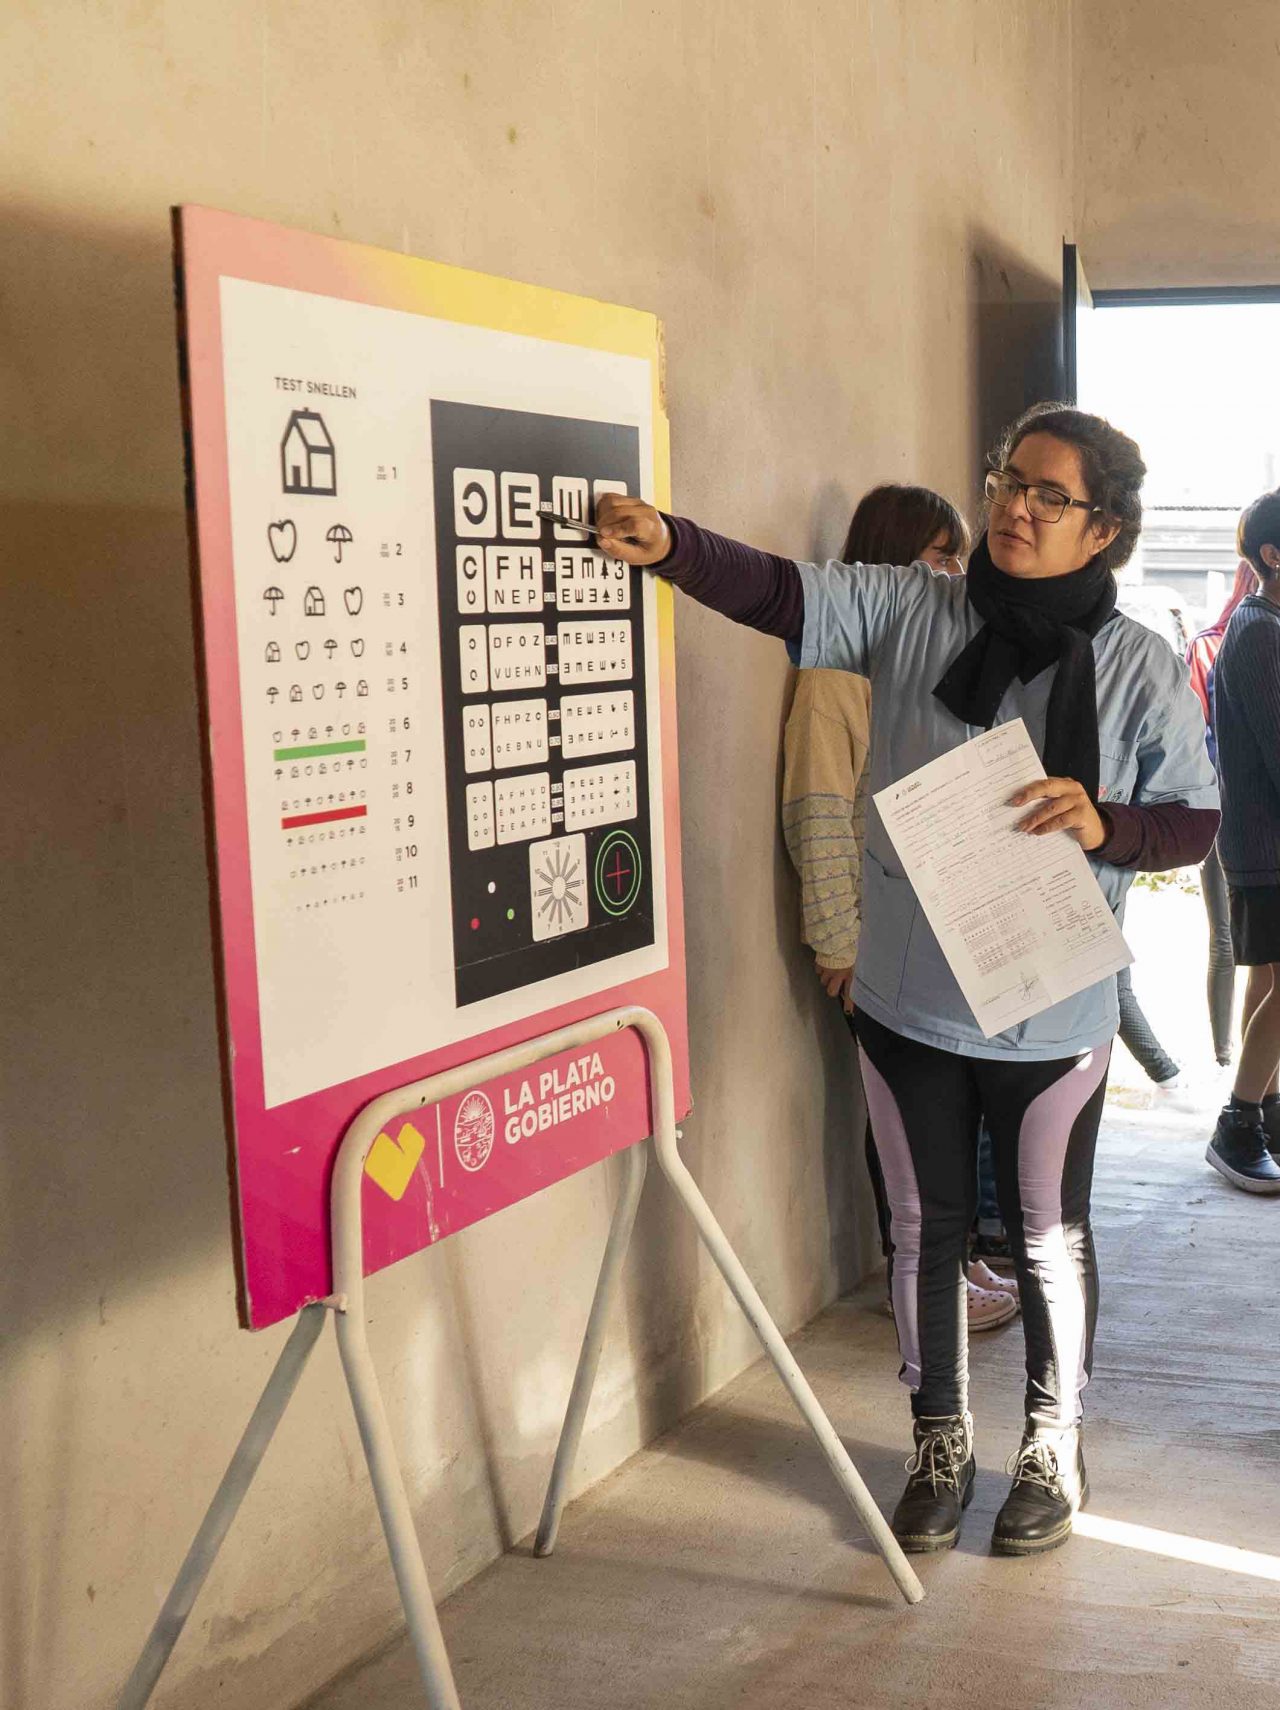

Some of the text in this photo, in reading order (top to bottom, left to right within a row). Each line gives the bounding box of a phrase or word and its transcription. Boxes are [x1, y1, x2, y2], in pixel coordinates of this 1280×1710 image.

[274, 377, 357, 399] TEST SNELLEN
[392, 466, 397, 480] 1
[508, 485, 533, 528] E
[396, 543, 402, 556] 2
[398, 593, 404, 606] 3
[400, 641, 407, 654] 4
[402, 677, 408, 690] 5
[403, 717, 410, 730] 6
[405, 750, 411, 763] 7
[406, 782, 413, 794] 8
[408, 814, 414, 827] 9
[405, 844, 417, 858] 10
[408, 875, 417, 888] 11
[503, 1052, 605, 1115] LA PLATA
[504, 1076, 616, 1145] GOBIERNO
